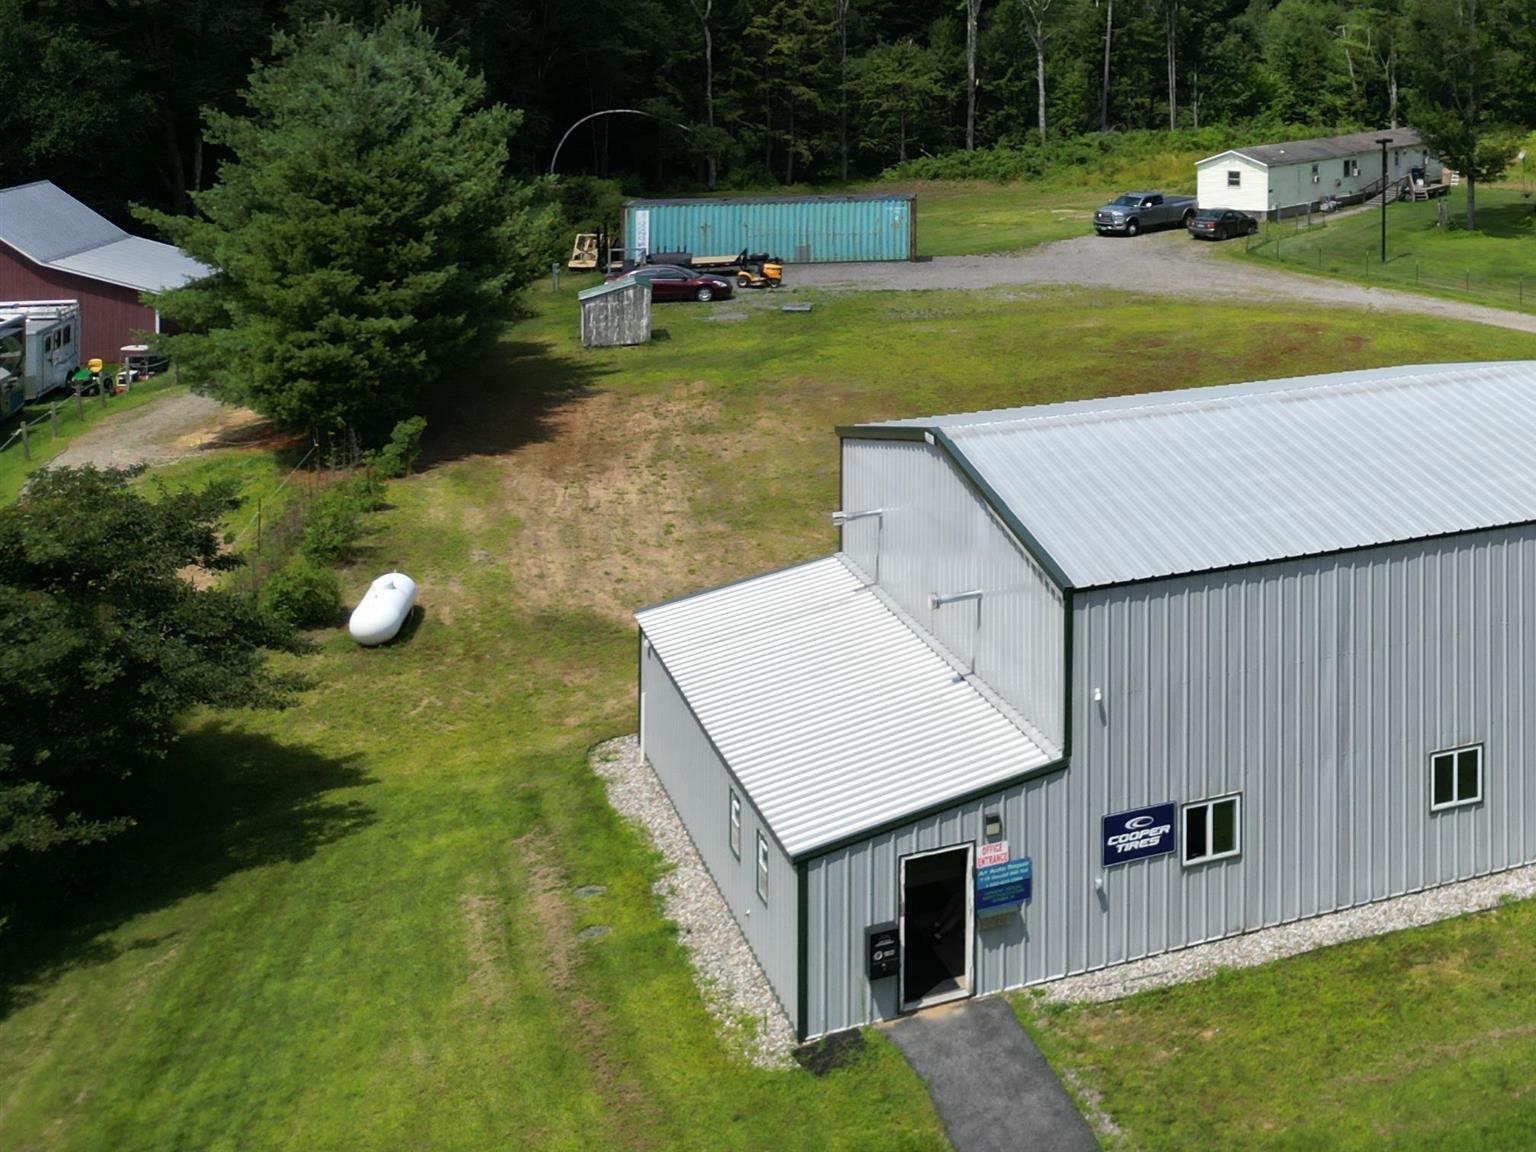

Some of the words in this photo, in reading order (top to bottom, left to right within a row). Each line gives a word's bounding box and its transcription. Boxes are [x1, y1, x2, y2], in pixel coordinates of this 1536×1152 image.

[1107, 824, 1171, 846] COOPER
[982, 843, 1002, 855] OFFICE
[1116, 836, 1161, 853] TIRES
[977, 852, 1008, 867] ENTRANCE
